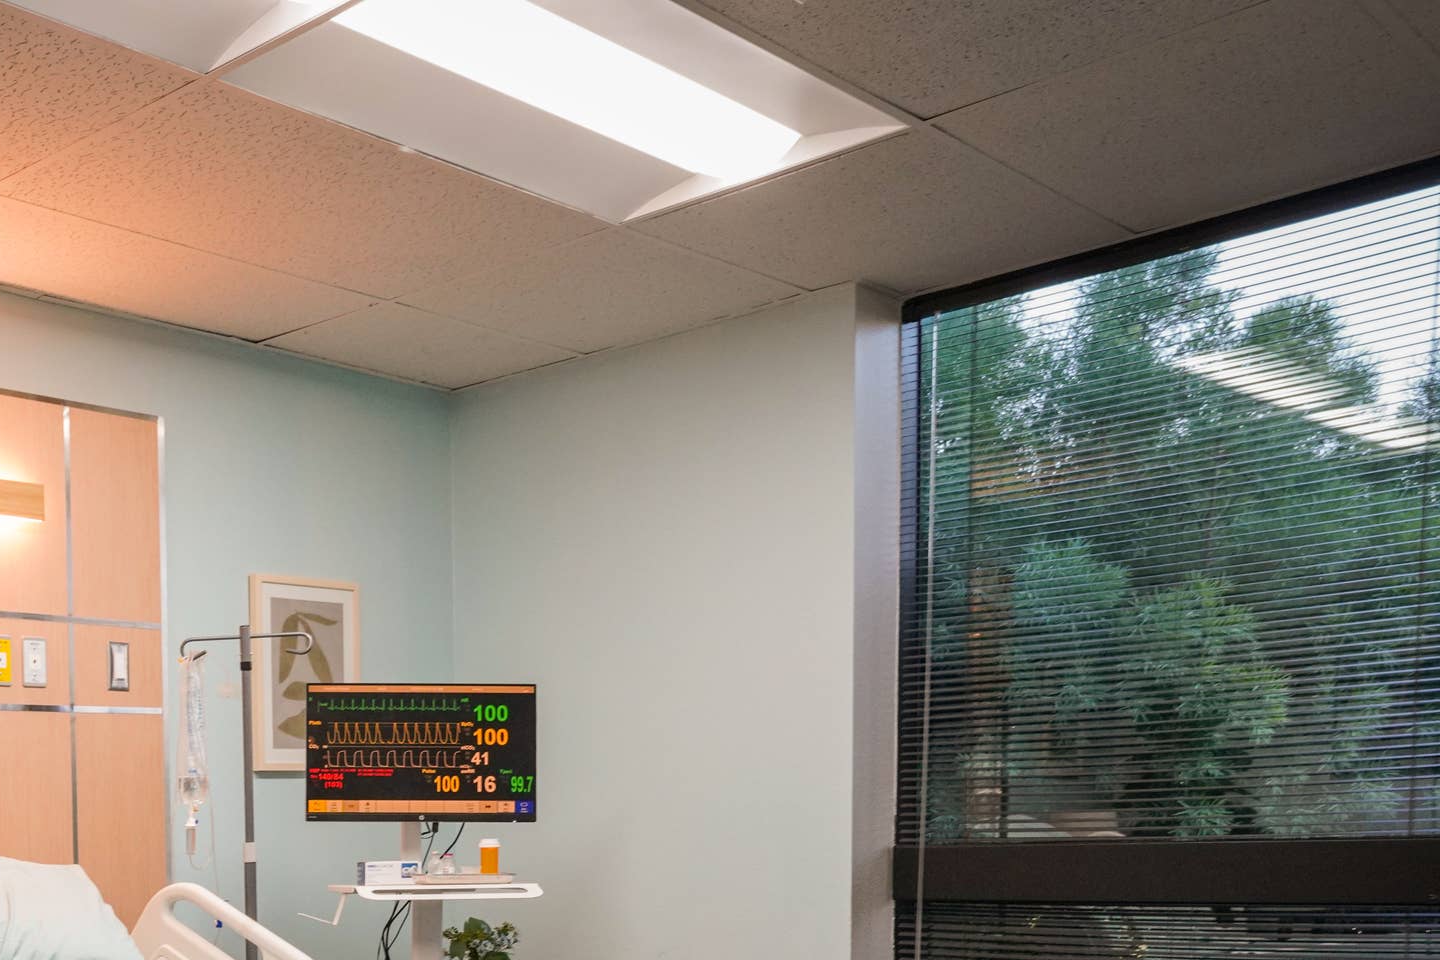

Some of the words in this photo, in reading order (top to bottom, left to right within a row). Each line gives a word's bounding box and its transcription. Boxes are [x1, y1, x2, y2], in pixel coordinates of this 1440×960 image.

[472, 704, 509, 722] 100
[472, 727, 509, 746] 100
[470, 751, 490, 766] 41
[433, 775, 461, 793] 100
[472, 775, 497, 793] 16
[510, 775, 534, 793] 99.7
